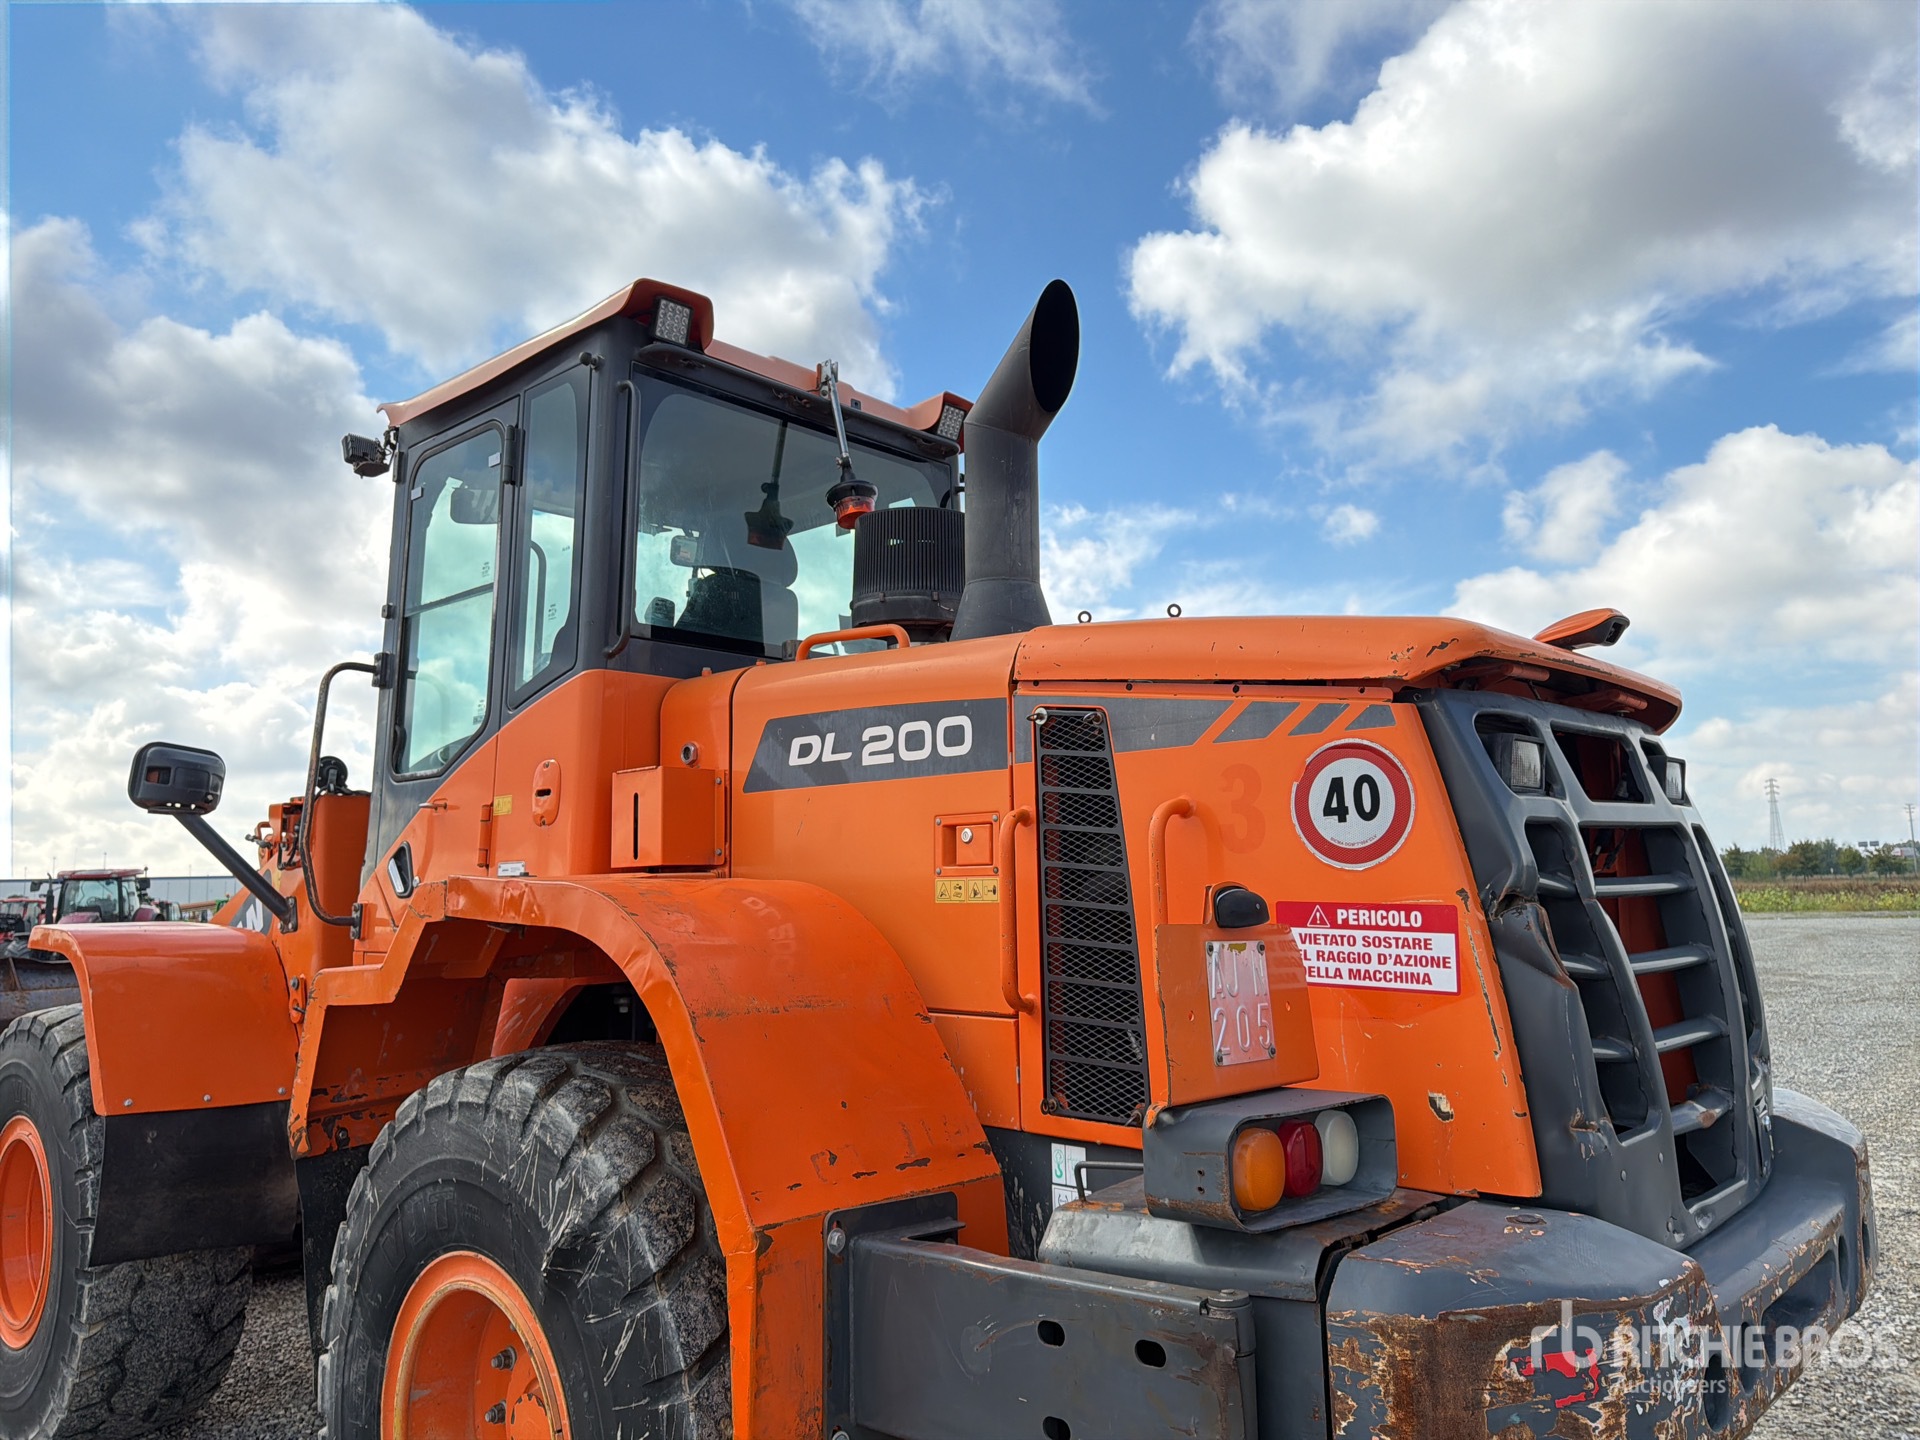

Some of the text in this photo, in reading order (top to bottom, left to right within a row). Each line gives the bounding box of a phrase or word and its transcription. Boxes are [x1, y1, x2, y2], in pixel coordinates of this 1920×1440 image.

[788, 715, 973, 766] DL 200
[1218, 763, 1266, 854] 3
[1323, 774, 1381, 823] 40
[1336, 909, 1423, 928] PERICOLO
[1299, 933, 1433, 950] VIETATO SOSTARE
[1316, 950, 1372, 965] RAGGIO
[1348, 968, 1433, 986] MACCHINA
[1213, 1003, 1270, 1055] 205
